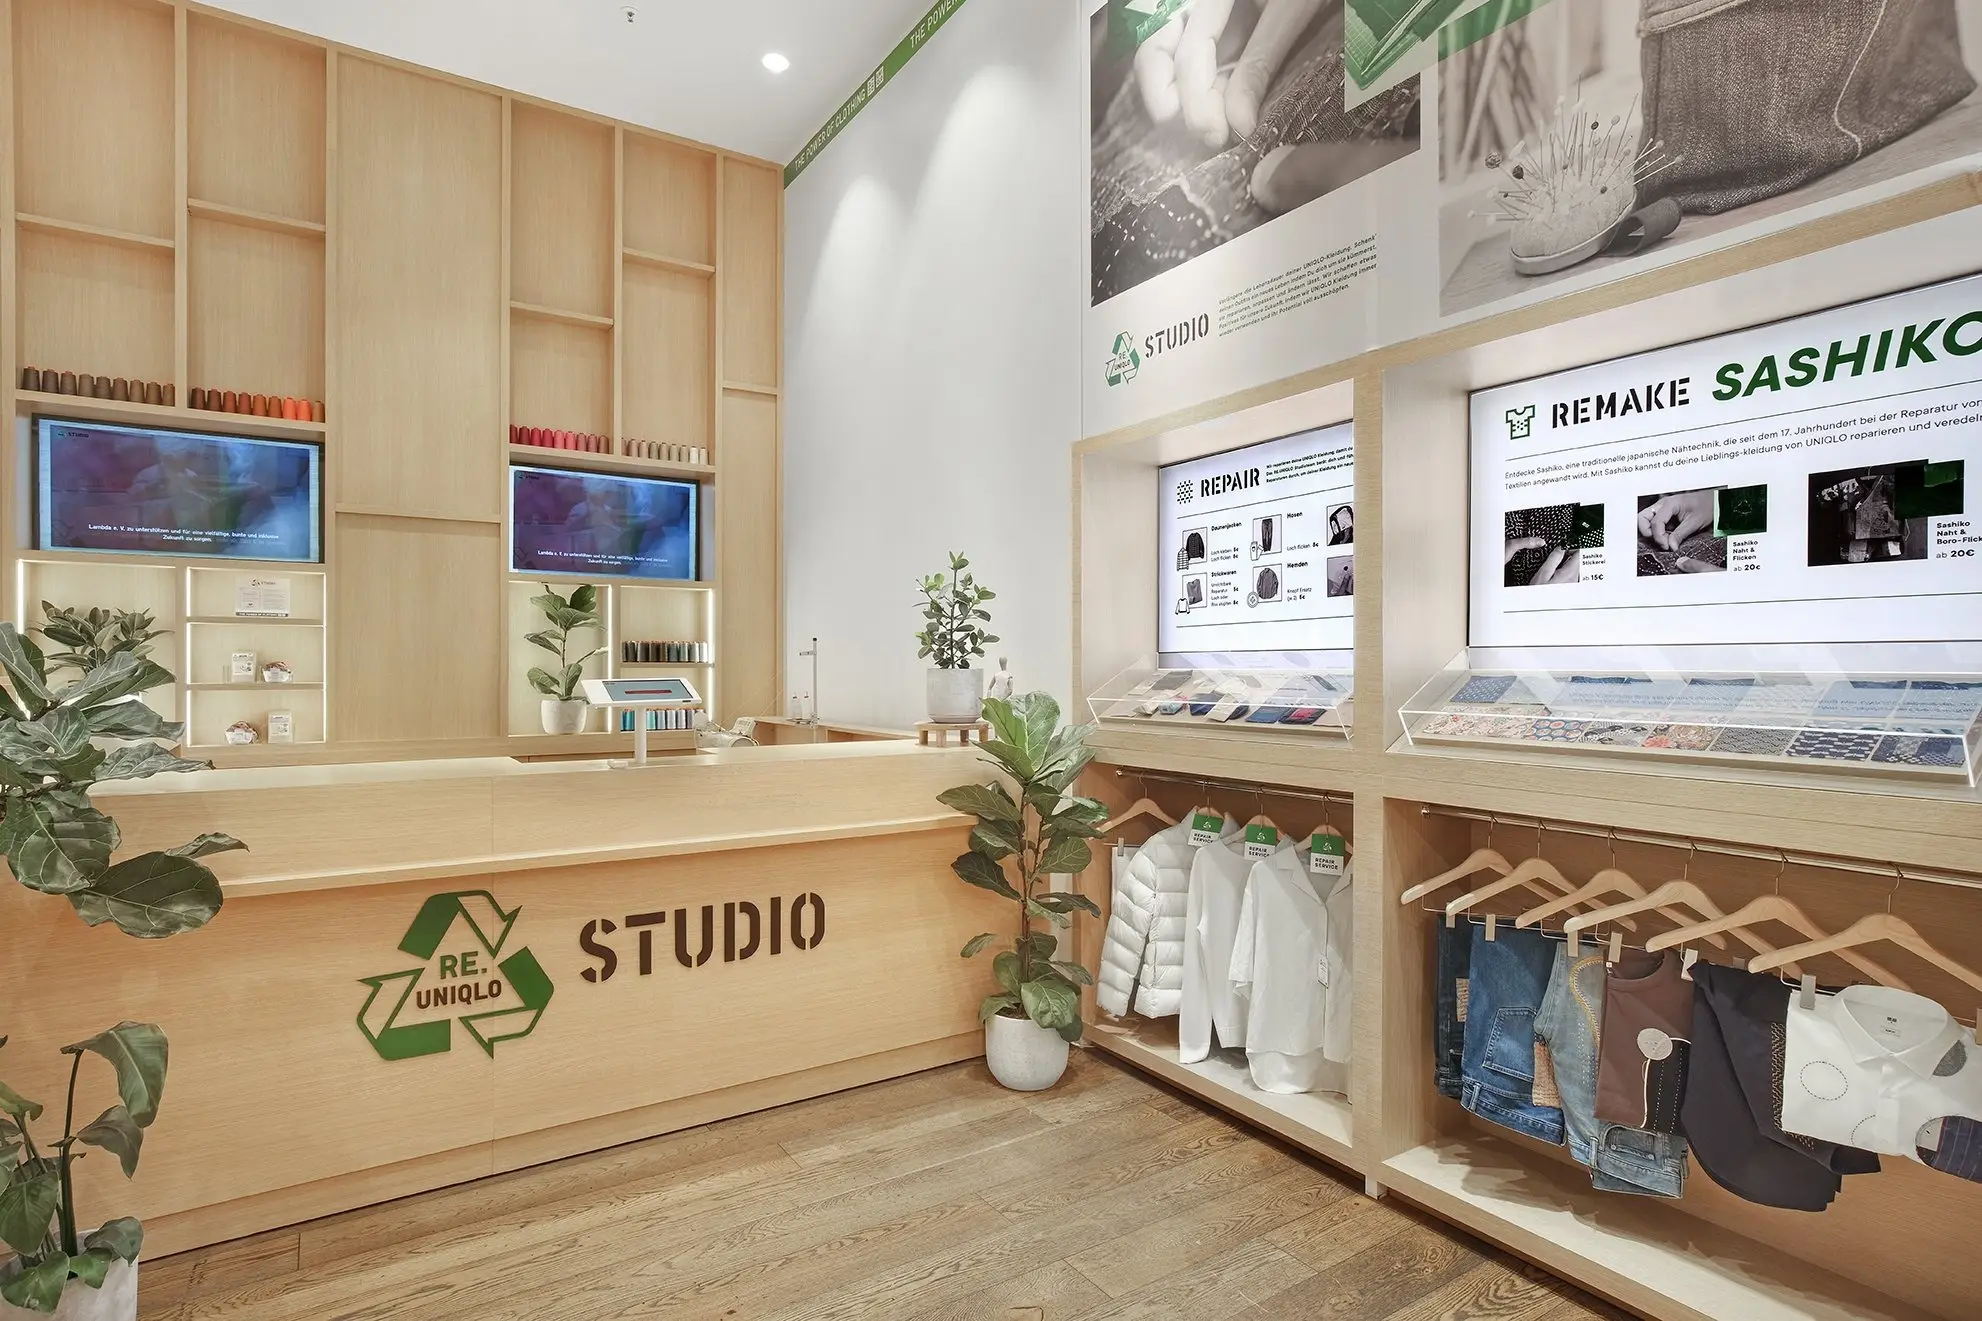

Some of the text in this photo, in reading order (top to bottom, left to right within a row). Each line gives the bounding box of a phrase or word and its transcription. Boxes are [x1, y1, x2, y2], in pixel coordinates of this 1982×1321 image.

[910, 23, 925, 48] THE
[795, 88, 866, 171] THE POWER OF CLOTHING
[1322, 271, 1332, 280] Wir
[1359, 253, 1376, 265] etwas
[1328, 260, 1336, 268] um
[1332, 270, 1357, 284] Kleidung
[1358, 262, 1376, 274] immer
[1145, 313, 1209, 358] STUDIO
[1552, 311, 1982, 429] REMAKE SASHIKO
[1504, 468, 1535, 479] Entdecke
[1536, 463, 1563, 474] Sashiko,
[1565, 461, 1580, 469] eine
[1581, 454, 1625, 467] traditionelle
[1626, 447, 1669, 460] japanische
[1671, 439, 1721, 453] Nähtechnik,
[1723, 437, 1737, 445] die
[1739, 434, 1755, 443] seit
[1757, 430, 1778, 440] dem
[1780, 428, 1791, 437] 17.
[1794, 418, 1856, 435] Jahrhundert
[1859, 415, 1875, 425] bei
[1878, 412, 1897, 422] der
[1900, 402, 1958, 419] Reparatur
[1505, 480, 1531, 490] Textilien
[1532, 474, 1570, 485] angewandt
[1604, 465, 1633, 475] Sashiko
[1634, 461, 1660, 471] kannst
[1662, 459, 1673, 467] du
[1675, 455, 1698, 465] deine
[1700, 443, 1782, 461] Lieblings-kleidung
[1784, 440, 1802, 449] von
[1805, 433, 1847, 446] UNIQLO
[1850, 425, 1905, 439] reparieren
[1908, 421, 1930, 431] und
[1201, 468, 1259, 497] REPAIR
[1951, 549, 1974, 557] 20€
[580, 892, 825, 983] STUDIO
[440, 951, 487, 979] RE.
[416, 980, 501, 1009] UNIQLO
